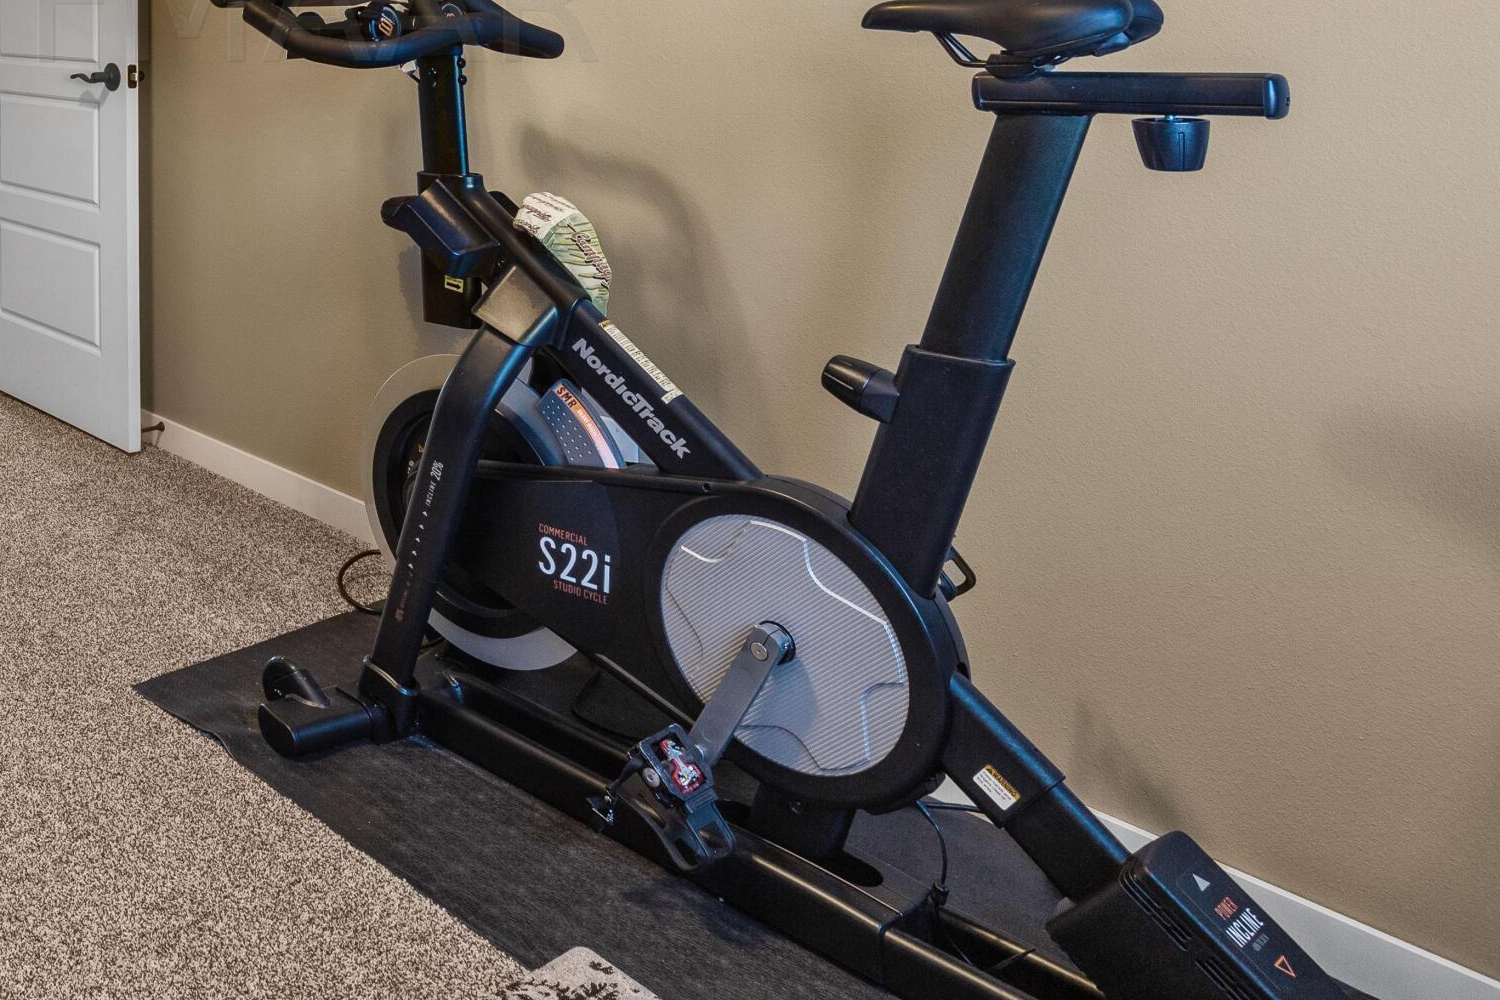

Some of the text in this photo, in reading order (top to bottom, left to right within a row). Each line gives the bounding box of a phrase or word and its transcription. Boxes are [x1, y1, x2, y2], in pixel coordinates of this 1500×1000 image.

[556, 386, 578, 409] SMR
[571, 337, 691, 460] NordicTrack
[425, 460, 444, 507] INCLINE 20%
[538, 523, 588, 546] COMMERCIAL
[538, 536, 611, 594] S22i
[553, 580, 609, 605] STUDIO CYCLE
[1225, 907, 1264, 948] INCLINE
